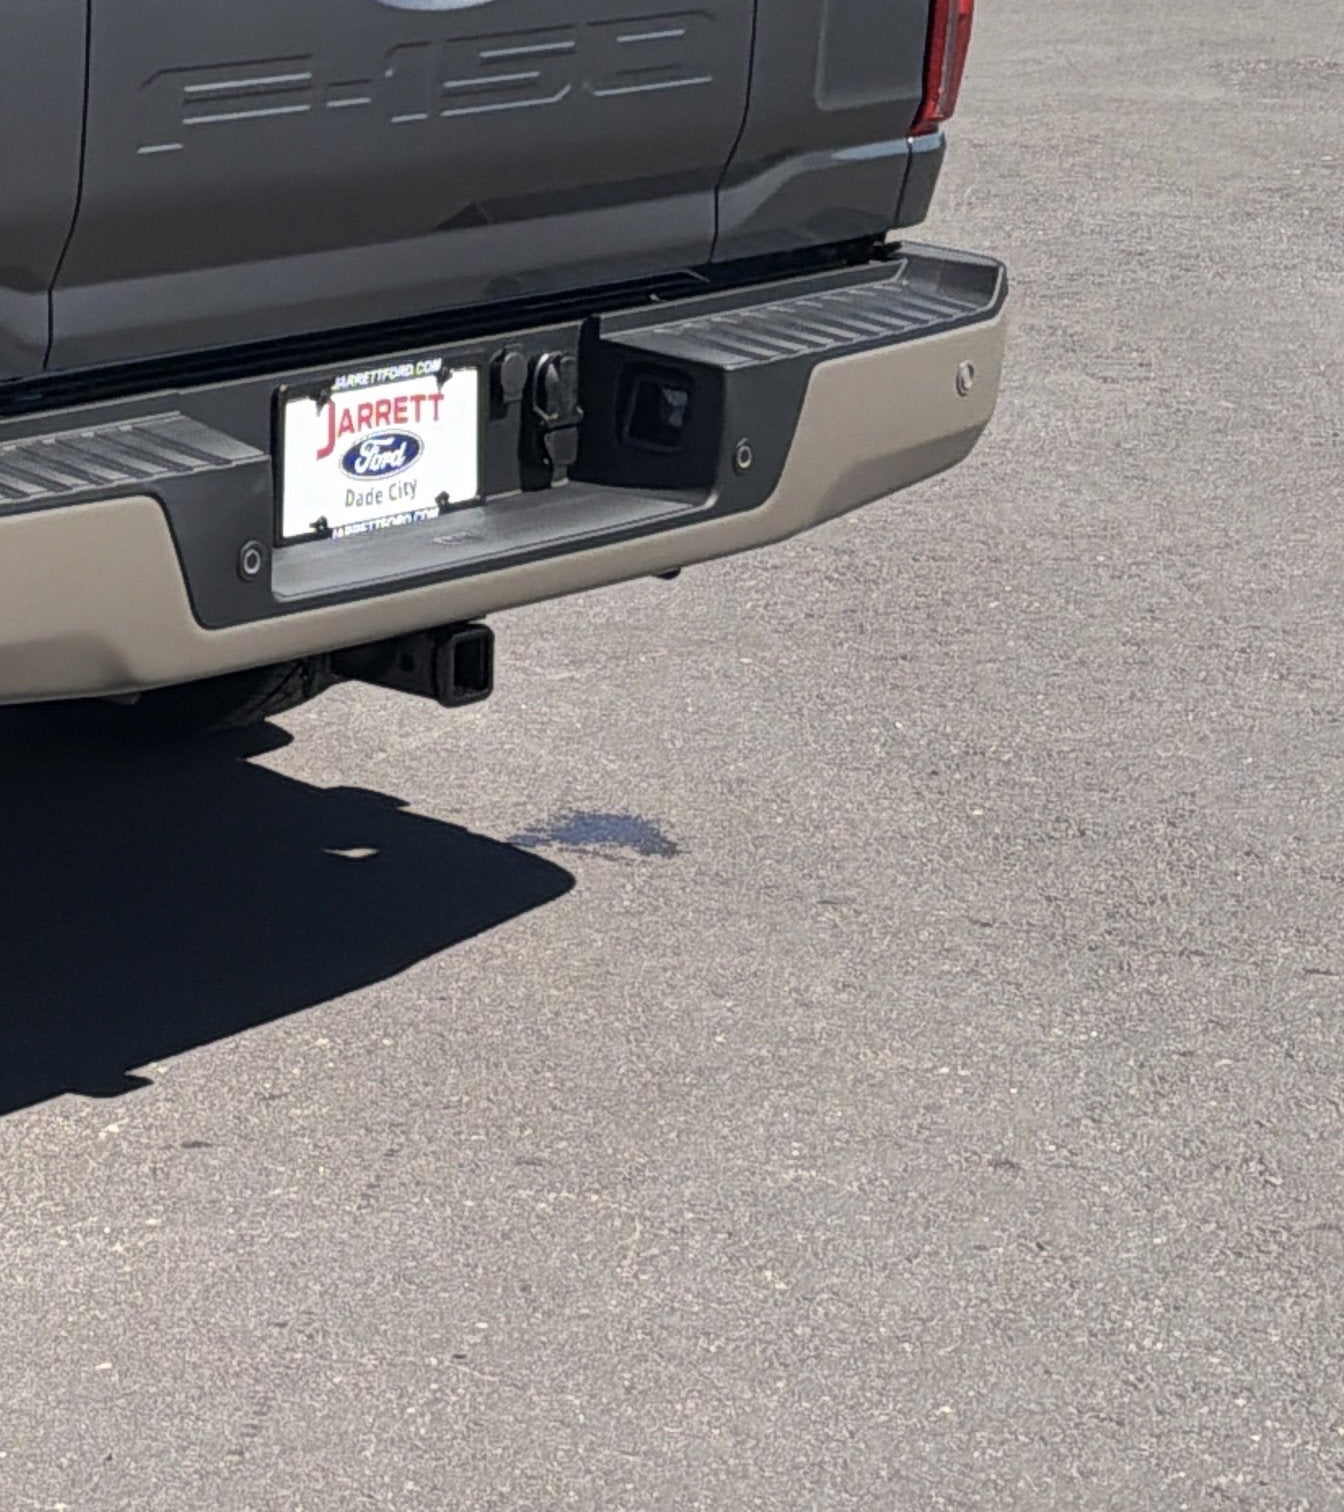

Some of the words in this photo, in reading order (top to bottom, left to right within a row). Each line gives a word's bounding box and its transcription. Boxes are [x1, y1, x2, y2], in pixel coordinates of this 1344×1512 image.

[136, 7, 715, 155] F-150
[316, 392, 445, 462] JARRETT
[354, 436, 408, 474] Ford
[344, 487, 383, 508] Dade
[388, 478, 418, 501] City
